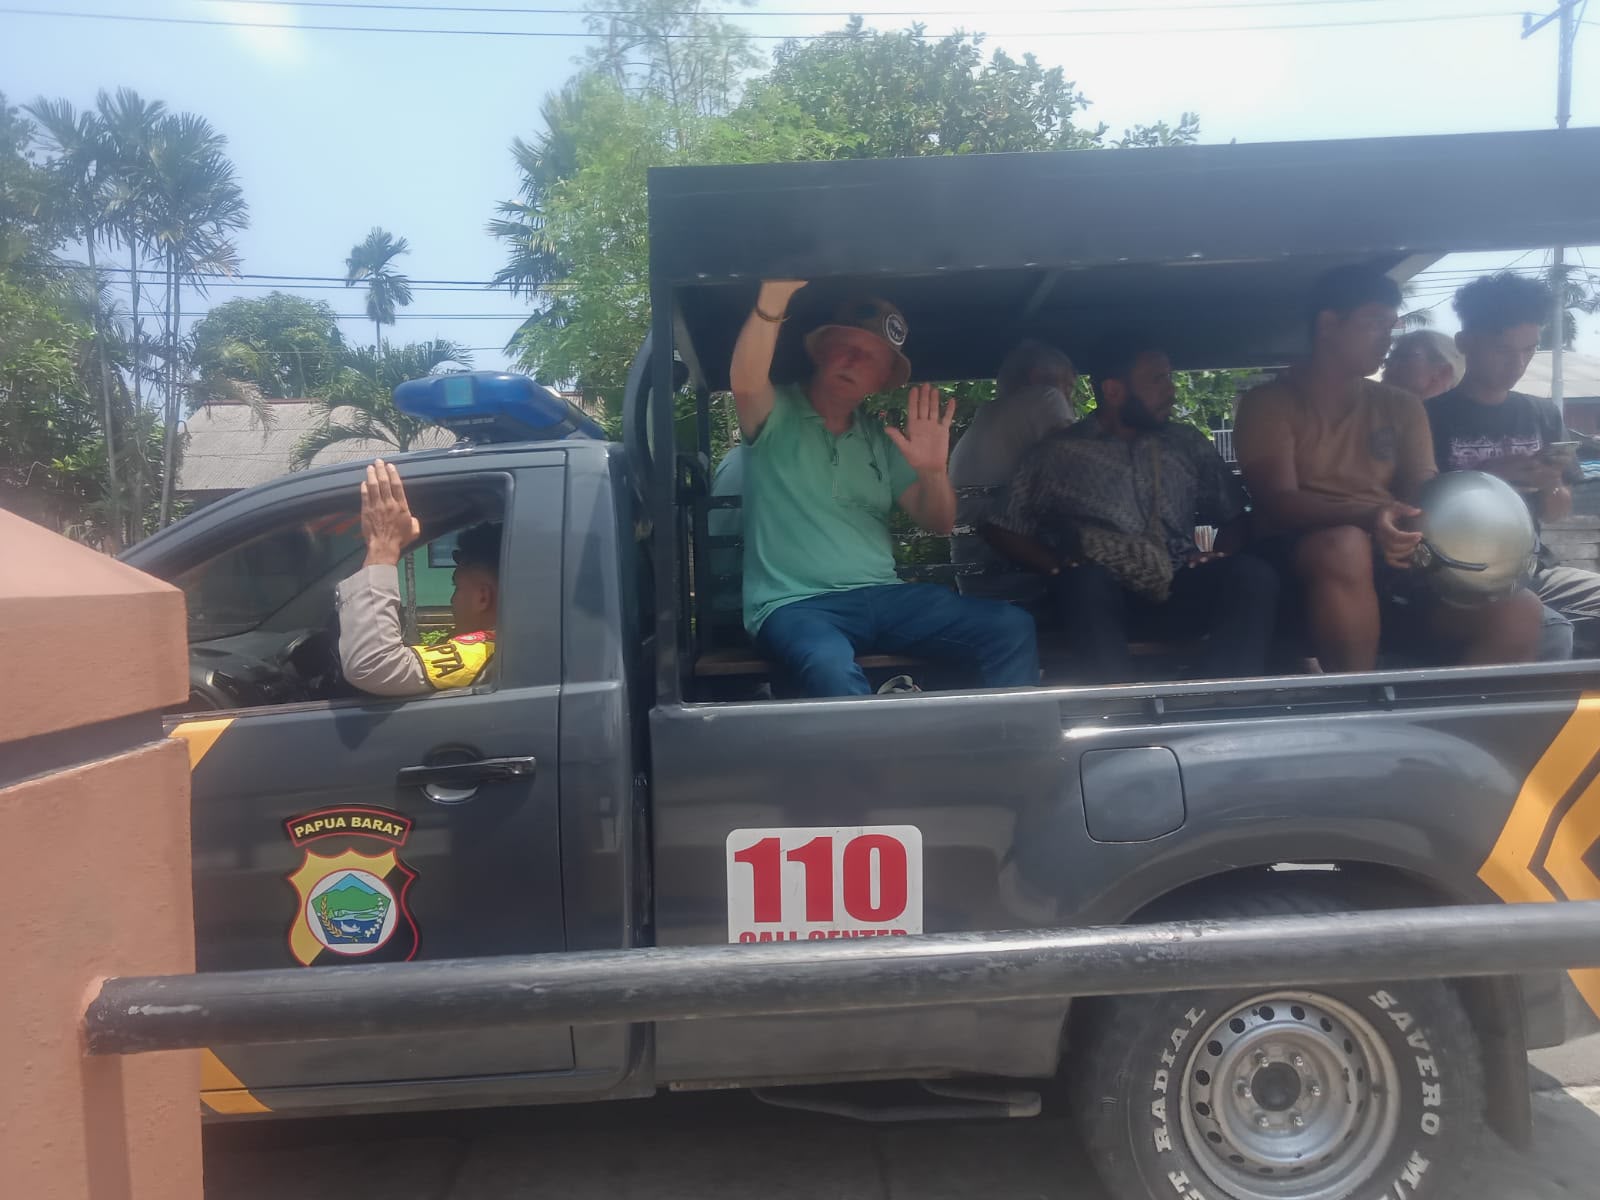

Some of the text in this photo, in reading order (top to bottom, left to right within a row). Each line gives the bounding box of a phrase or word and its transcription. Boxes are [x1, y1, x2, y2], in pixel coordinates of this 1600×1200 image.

[294, 817, 403, 838] PAPUA BARAT
[734, 833, 908, 924] 110
[1151, 1007, 1207, 1153] RADIAL
[1367, 990, 1441, 1200] SAVERO M/
